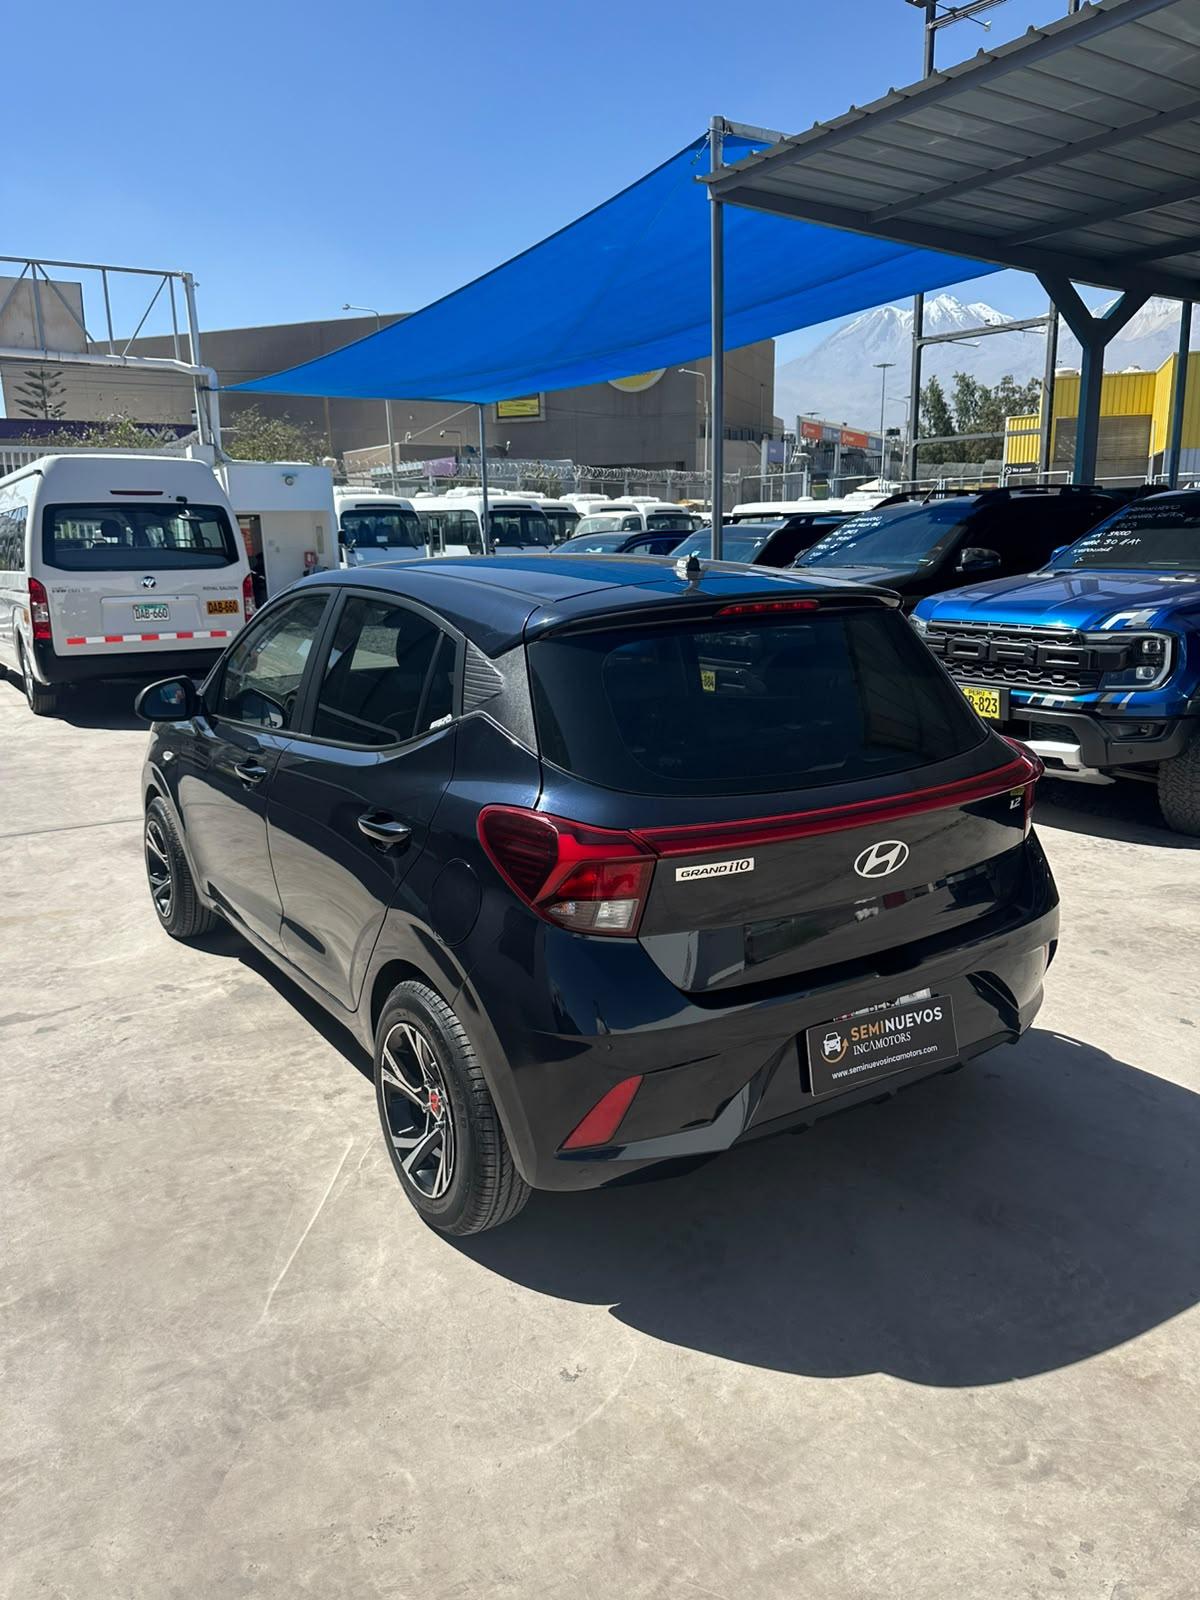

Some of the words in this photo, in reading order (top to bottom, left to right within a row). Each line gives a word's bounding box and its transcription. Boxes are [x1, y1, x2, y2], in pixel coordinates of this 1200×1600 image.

[135, 607, 168, 620] DAB-660
[207, 600, 239, 614] DAB-660
[681, 865, 728, 878] GRAND
[729, 860, 750, 873] i10
[851, 1006, 943, 1041] SEMINUEVOS
[853, 1031, 912, 1056] INCAMOTORS
[831, 1044, 938, 1080] www.seminuevosincamotors.com
